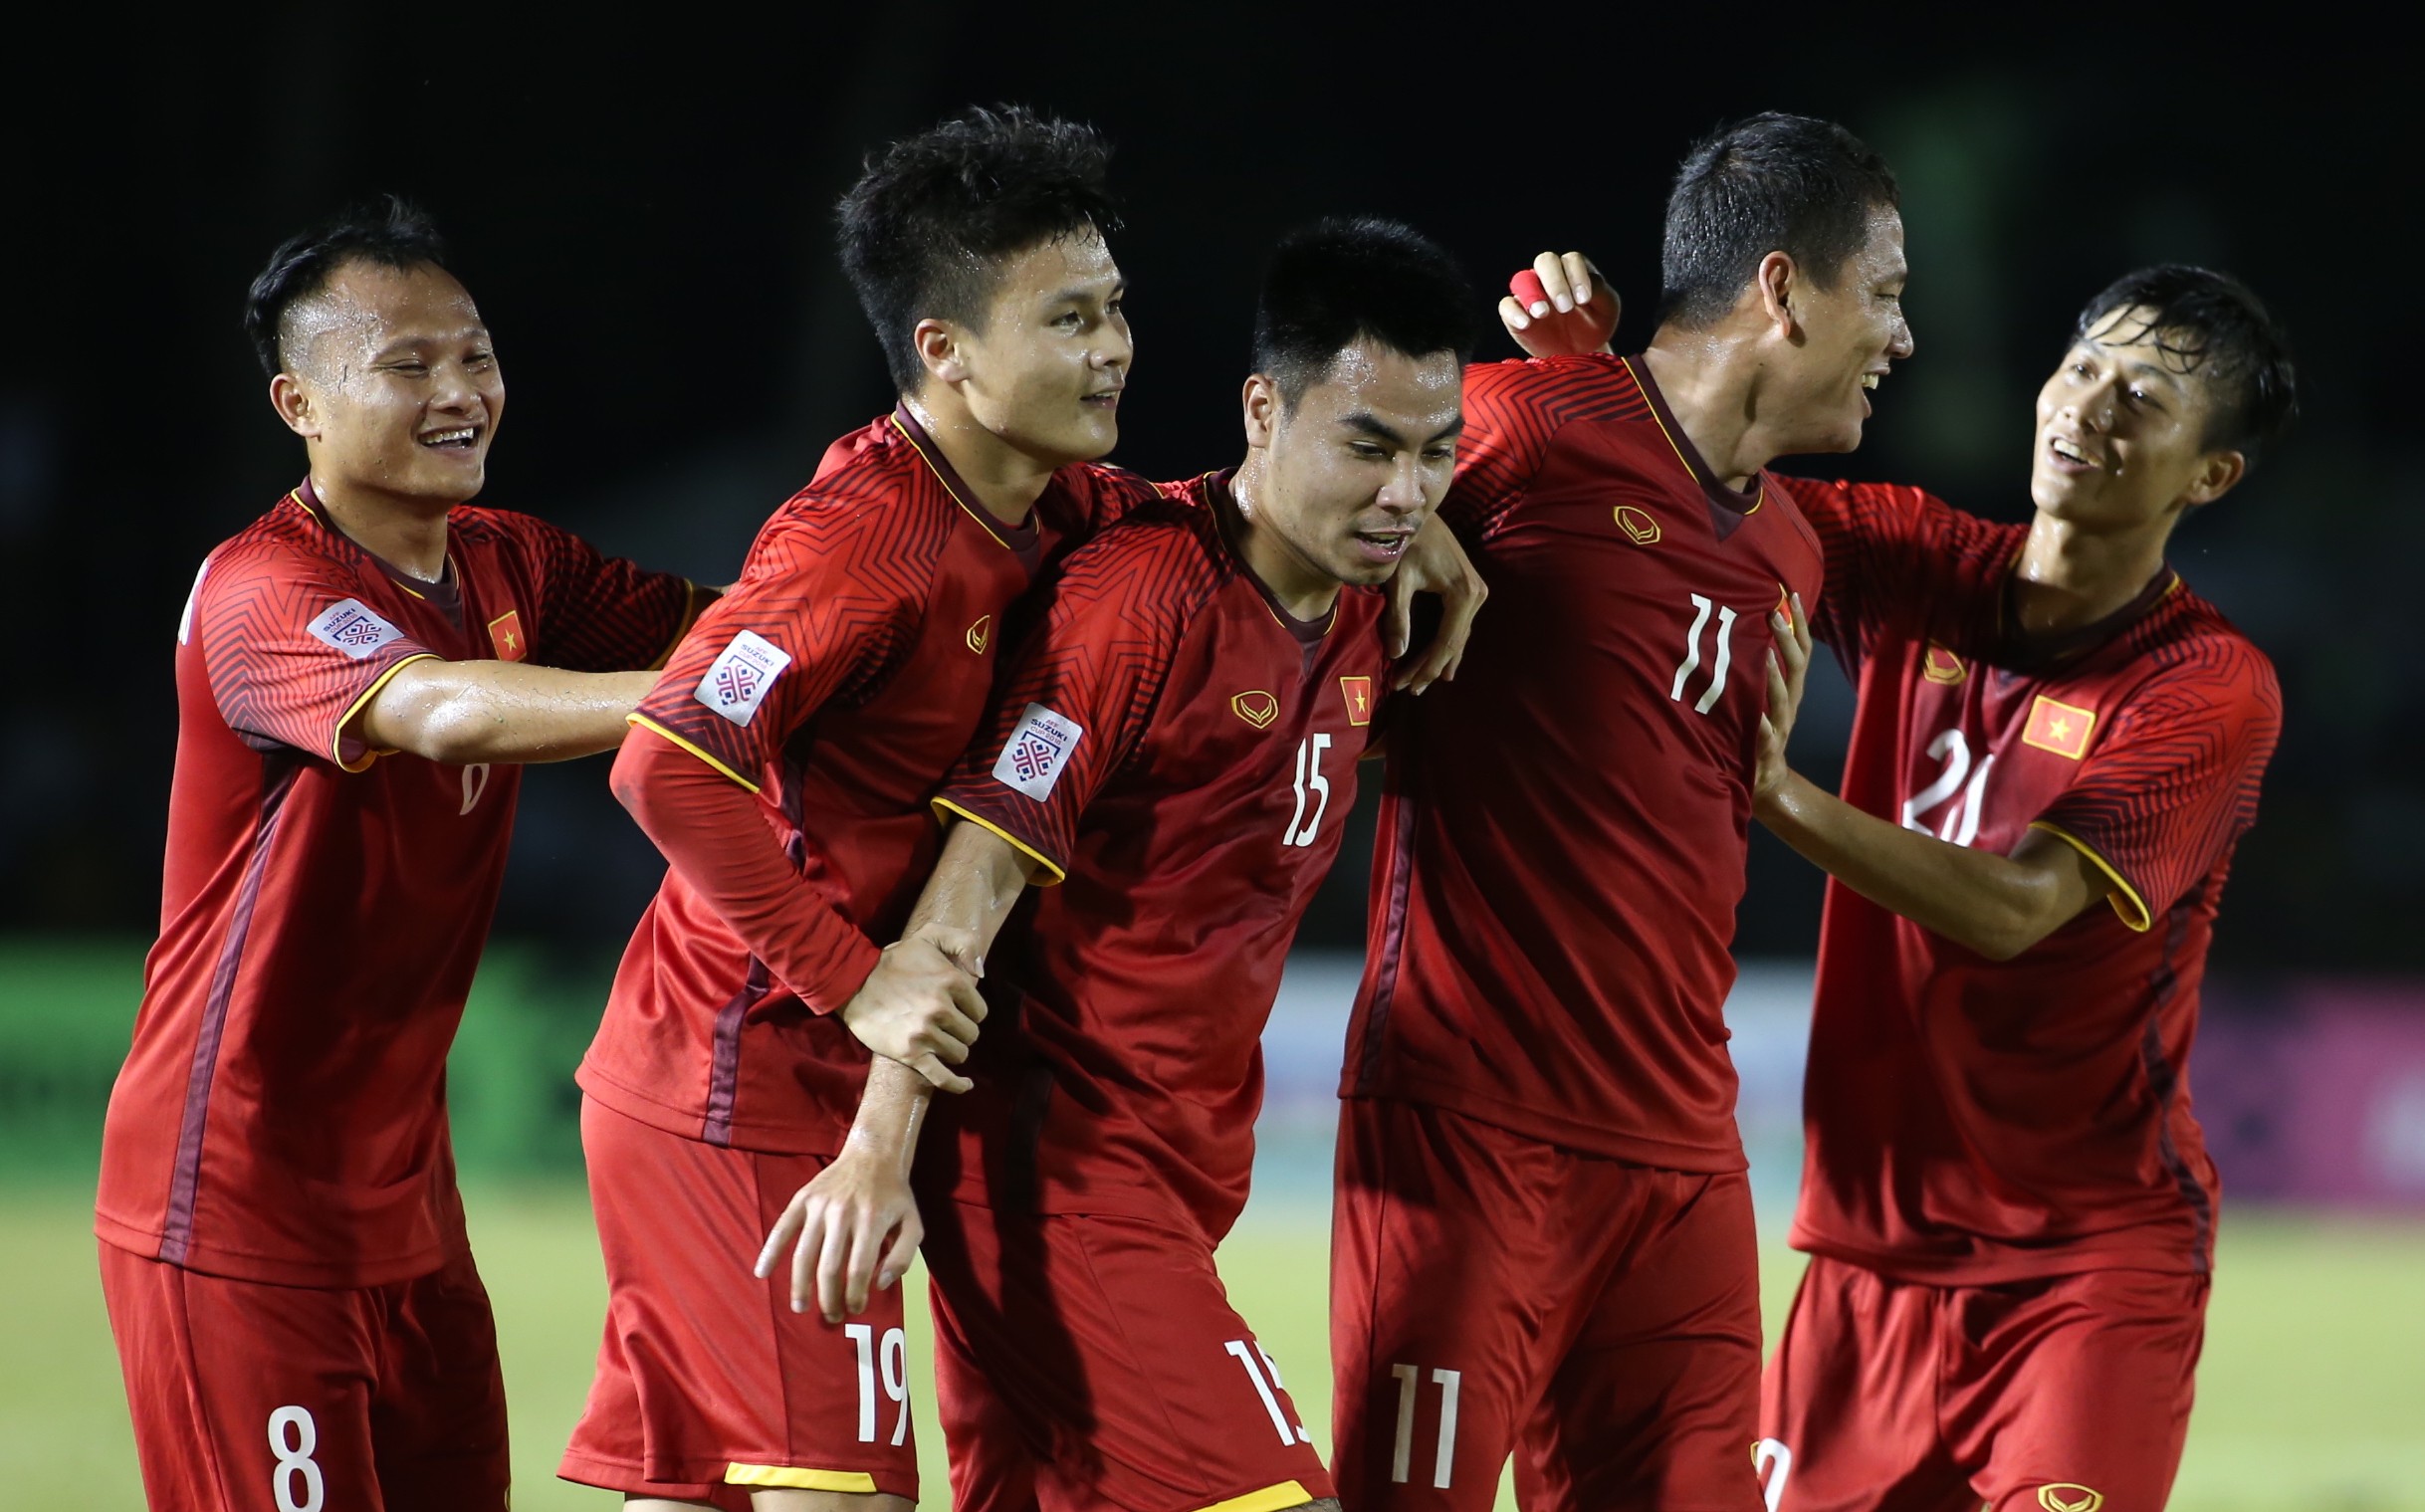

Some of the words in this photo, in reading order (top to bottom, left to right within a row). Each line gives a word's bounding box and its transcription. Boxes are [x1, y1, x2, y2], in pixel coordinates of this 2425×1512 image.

[323, 607, 356, 632] SUZUKI
[741, 644, 774, 667] SUZUKI
[1670, 592, 1737, 715] 11
[1030, 719, 1068, 742] SUZUKI
[1030, 726, 1045, 736] CUP
[1045, 733, 1062, 746] 2018
[1045, 720, 1059, 729] AFF
[1282, 733, 1332, 847] 15
[844, 1324, 908, 1446] 19
[268, 1404, 324, 1512] 8
[1392, 1364, 1460, 1489] 11
